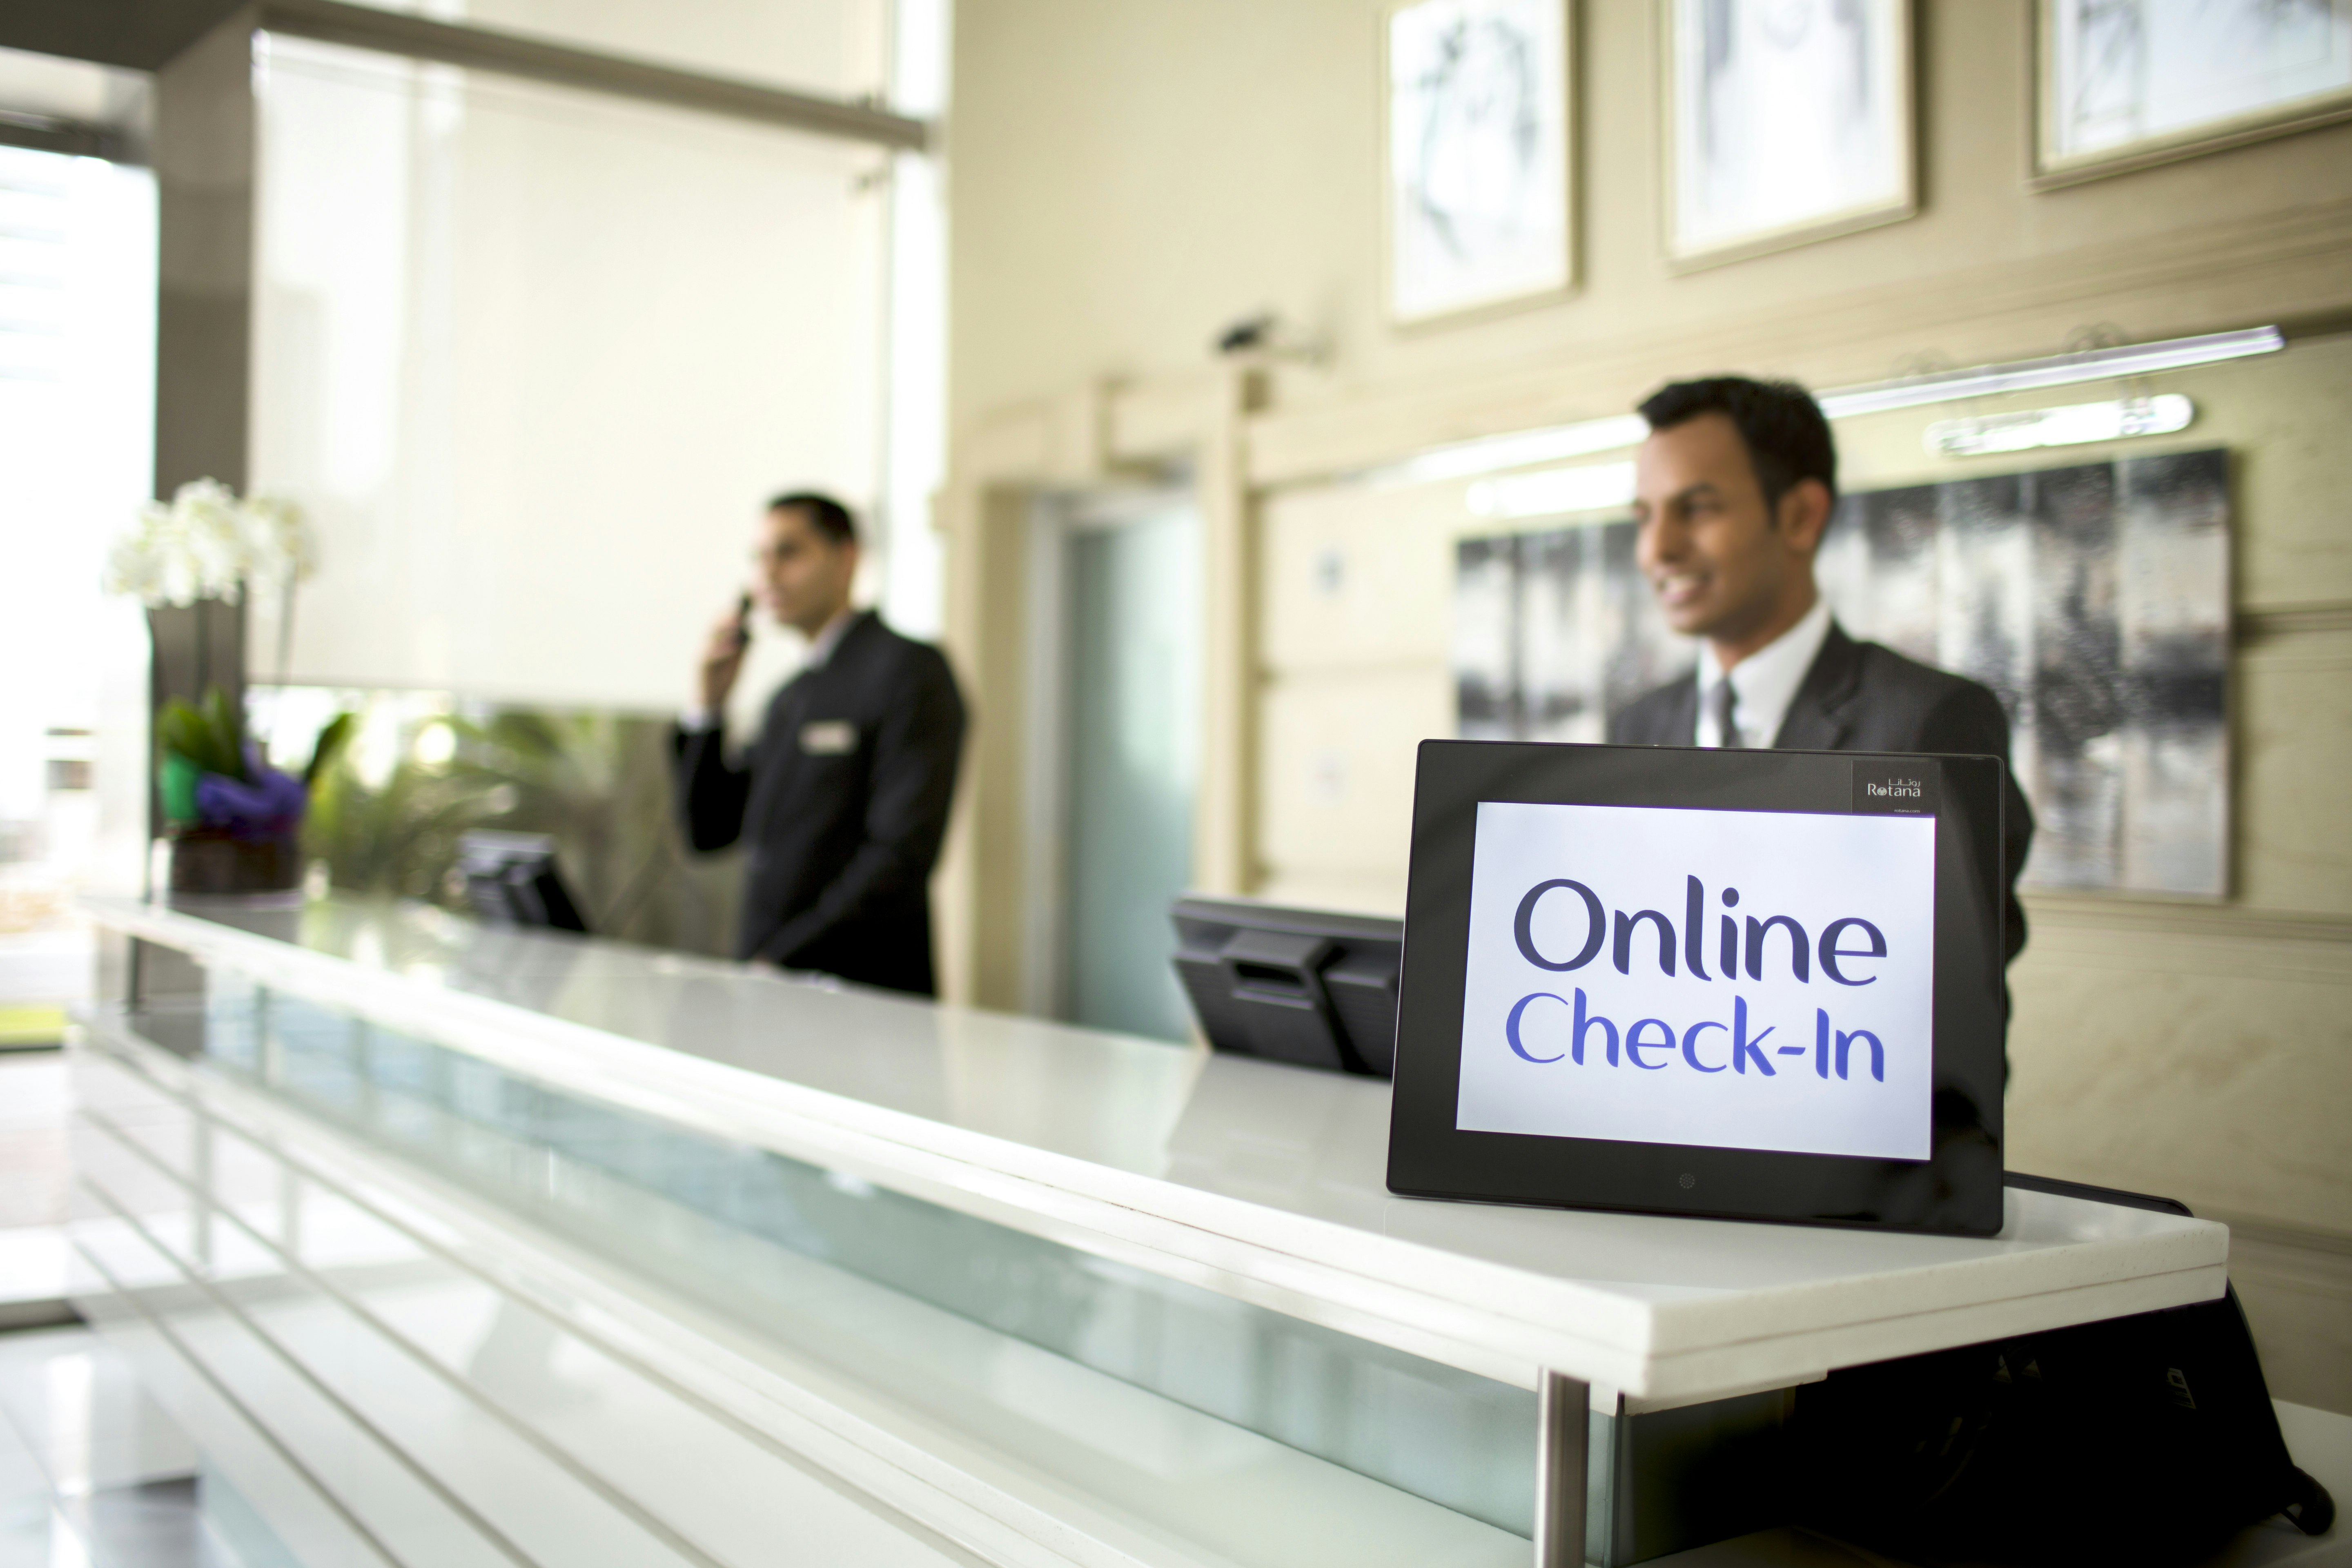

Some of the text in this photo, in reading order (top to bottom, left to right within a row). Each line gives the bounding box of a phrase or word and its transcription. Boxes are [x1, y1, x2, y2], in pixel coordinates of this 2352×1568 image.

[1868, 784, 1920, 797] Rotana
[1514, 874, 1887, 987] Online
[1506, 987, 1884, 1082] Check-In
